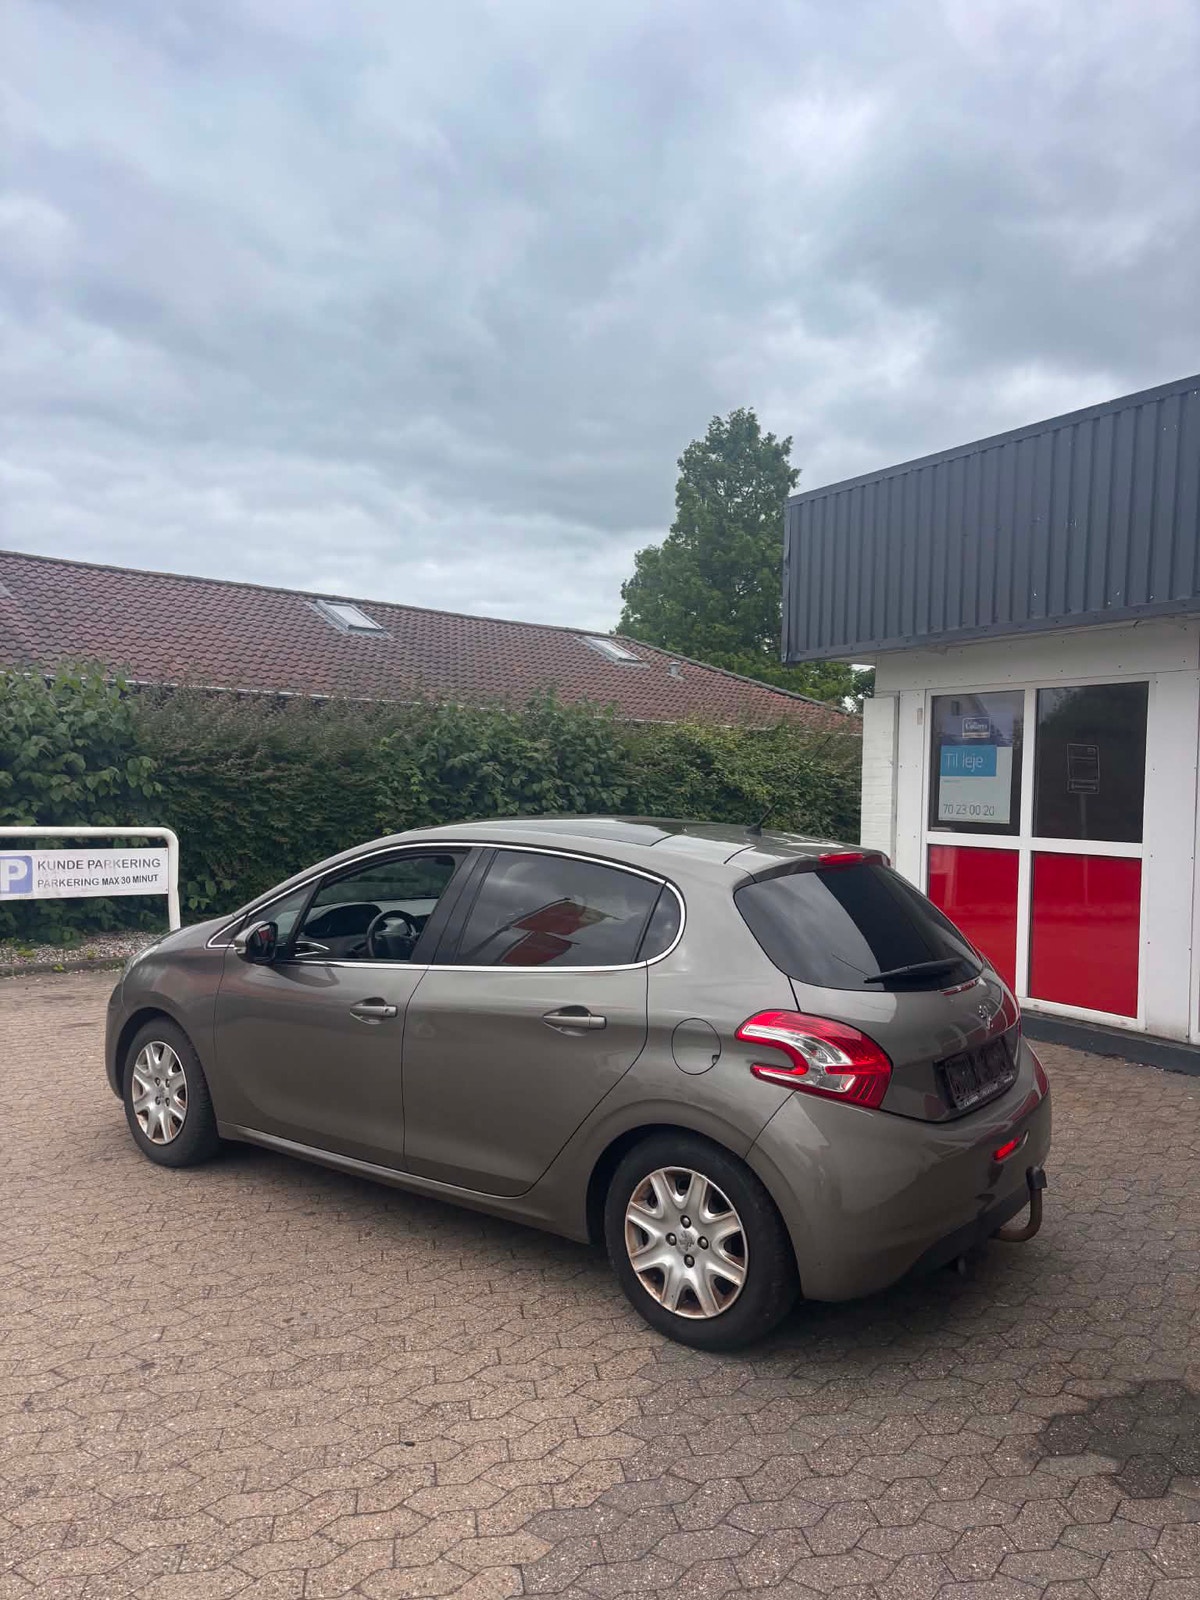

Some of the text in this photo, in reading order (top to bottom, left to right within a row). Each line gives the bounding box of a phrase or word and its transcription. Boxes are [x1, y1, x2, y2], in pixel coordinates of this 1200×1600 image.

[944, 751, 984, 773] Til leje
[944, 804, 995, 817] 70 23 00 20
[37, 858, 161, 871] KUNDE PARKERING
[1, 859, 28, 891] P
[37, 874, 159, 888] PARKERING MAX 30 MINUT
